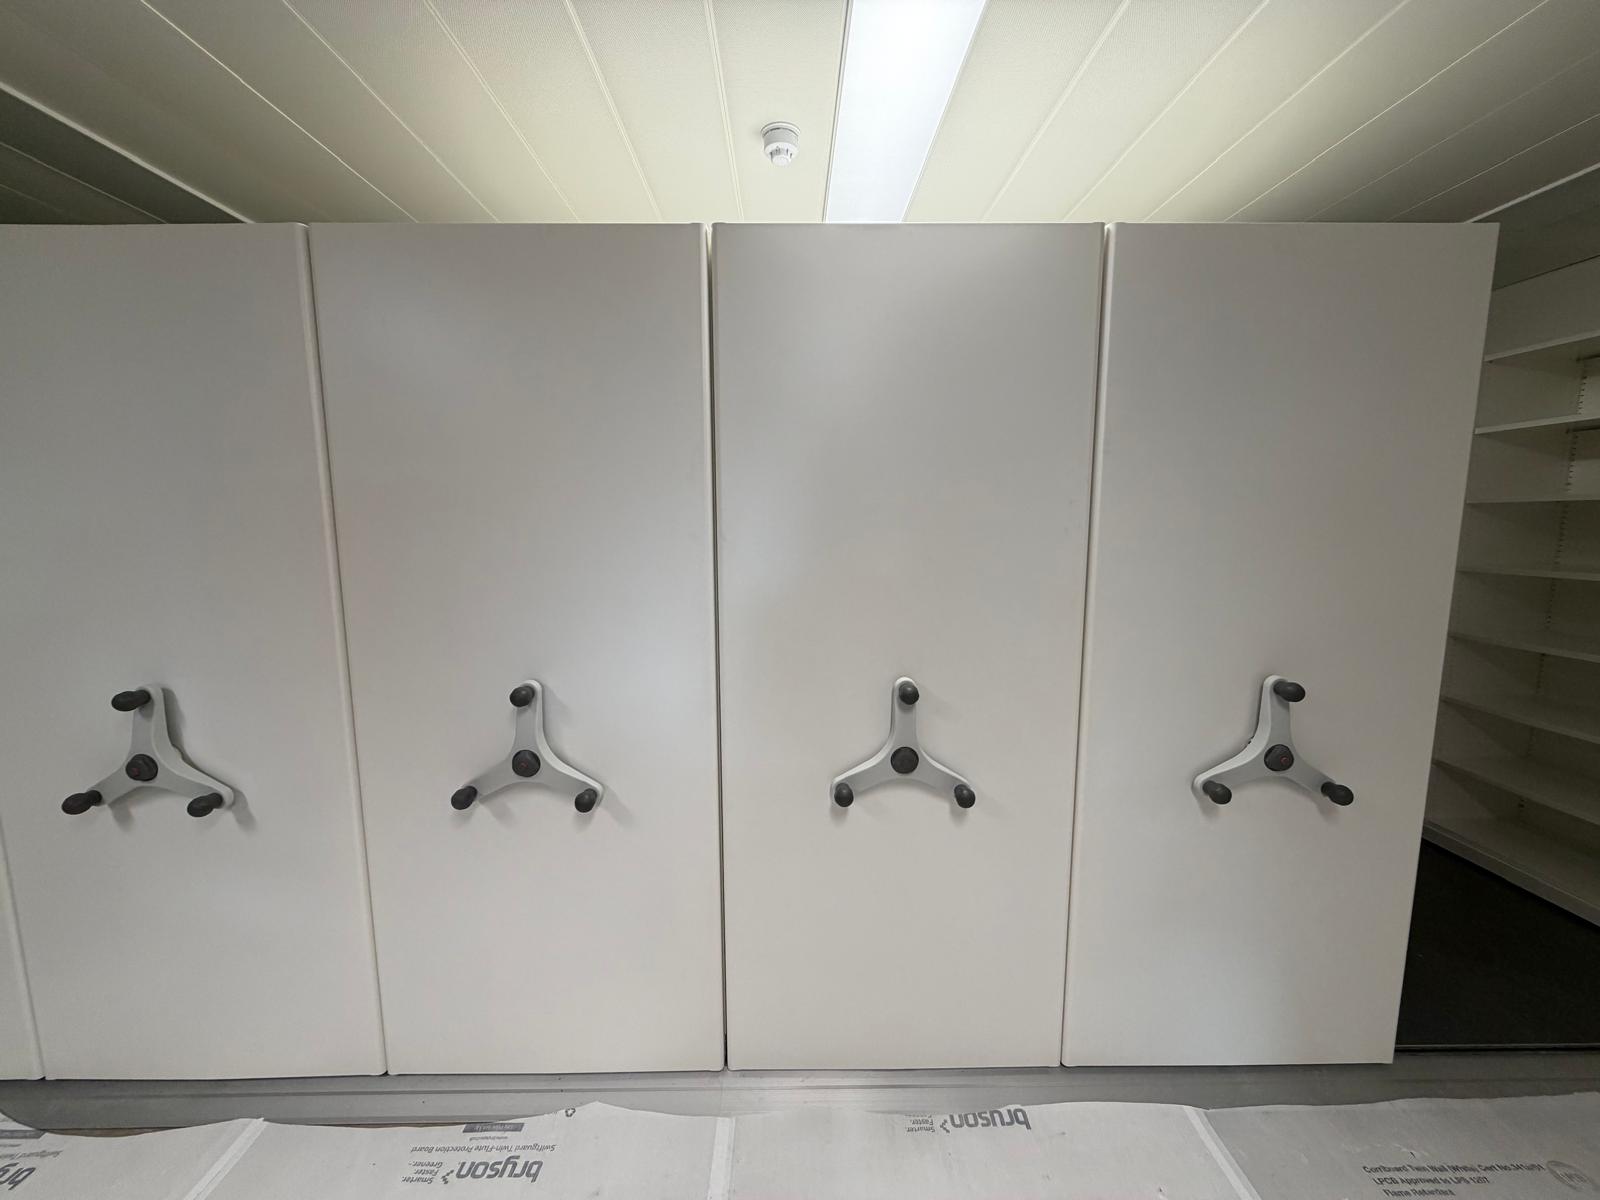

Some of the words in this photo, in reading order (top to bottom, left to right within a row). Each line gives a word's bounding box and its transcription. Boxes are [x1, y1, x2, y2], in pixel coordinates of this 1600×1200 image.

[410, 1146, 435, 1154] Board
[434, 1145, 474, 1153] Protection
[455, 1155, 544, 1184] bryson
